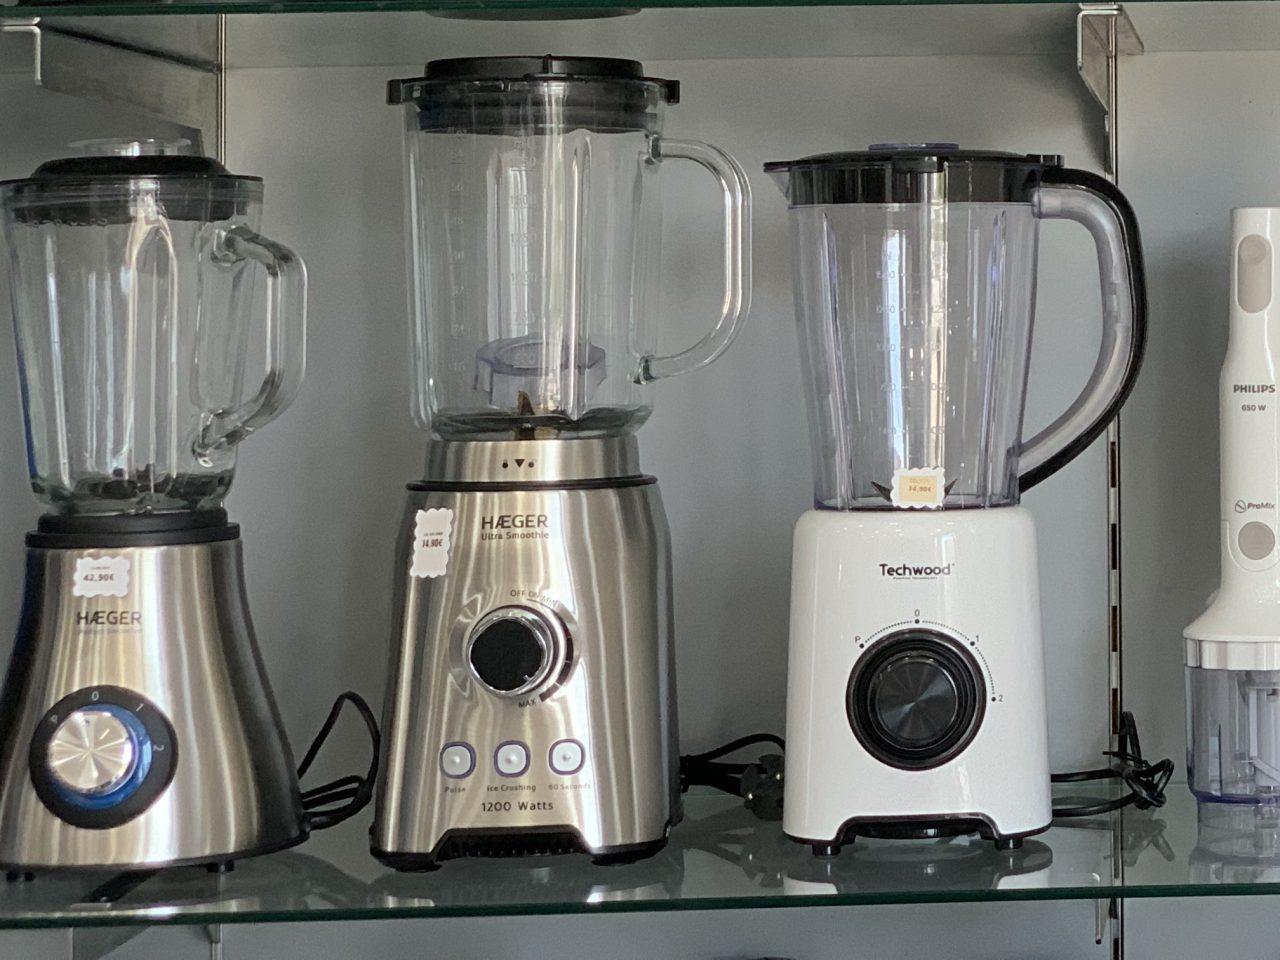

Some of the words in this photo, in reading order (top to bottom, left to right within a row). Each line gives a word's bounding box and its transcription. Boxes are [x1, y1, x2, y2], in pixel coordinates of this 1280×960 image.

[1233, 384, 1276, 394] PHILIPS
[1247, 502, 1275, 510] ProMix
[481, 514, 549, 530] HÆGER
[481, 531, 503, 540] Ultra
[506, 530, 549, 539] Smoothie
[879, 563, 951, 576] Techwood
[510, 589, 526, 597] OFF
[76, 610, 142, 626] HÆGER
[914, 609, 921, 617] 0
[91, 691, 99, 701] 0
[518, 700, 536, 708] MAX
[487, 784, 498, 792] Ice
[500, 784, 537, 792] Crushing
[481, 801, 512, 812] 1200
[518, 800, 554, 811] Watts
